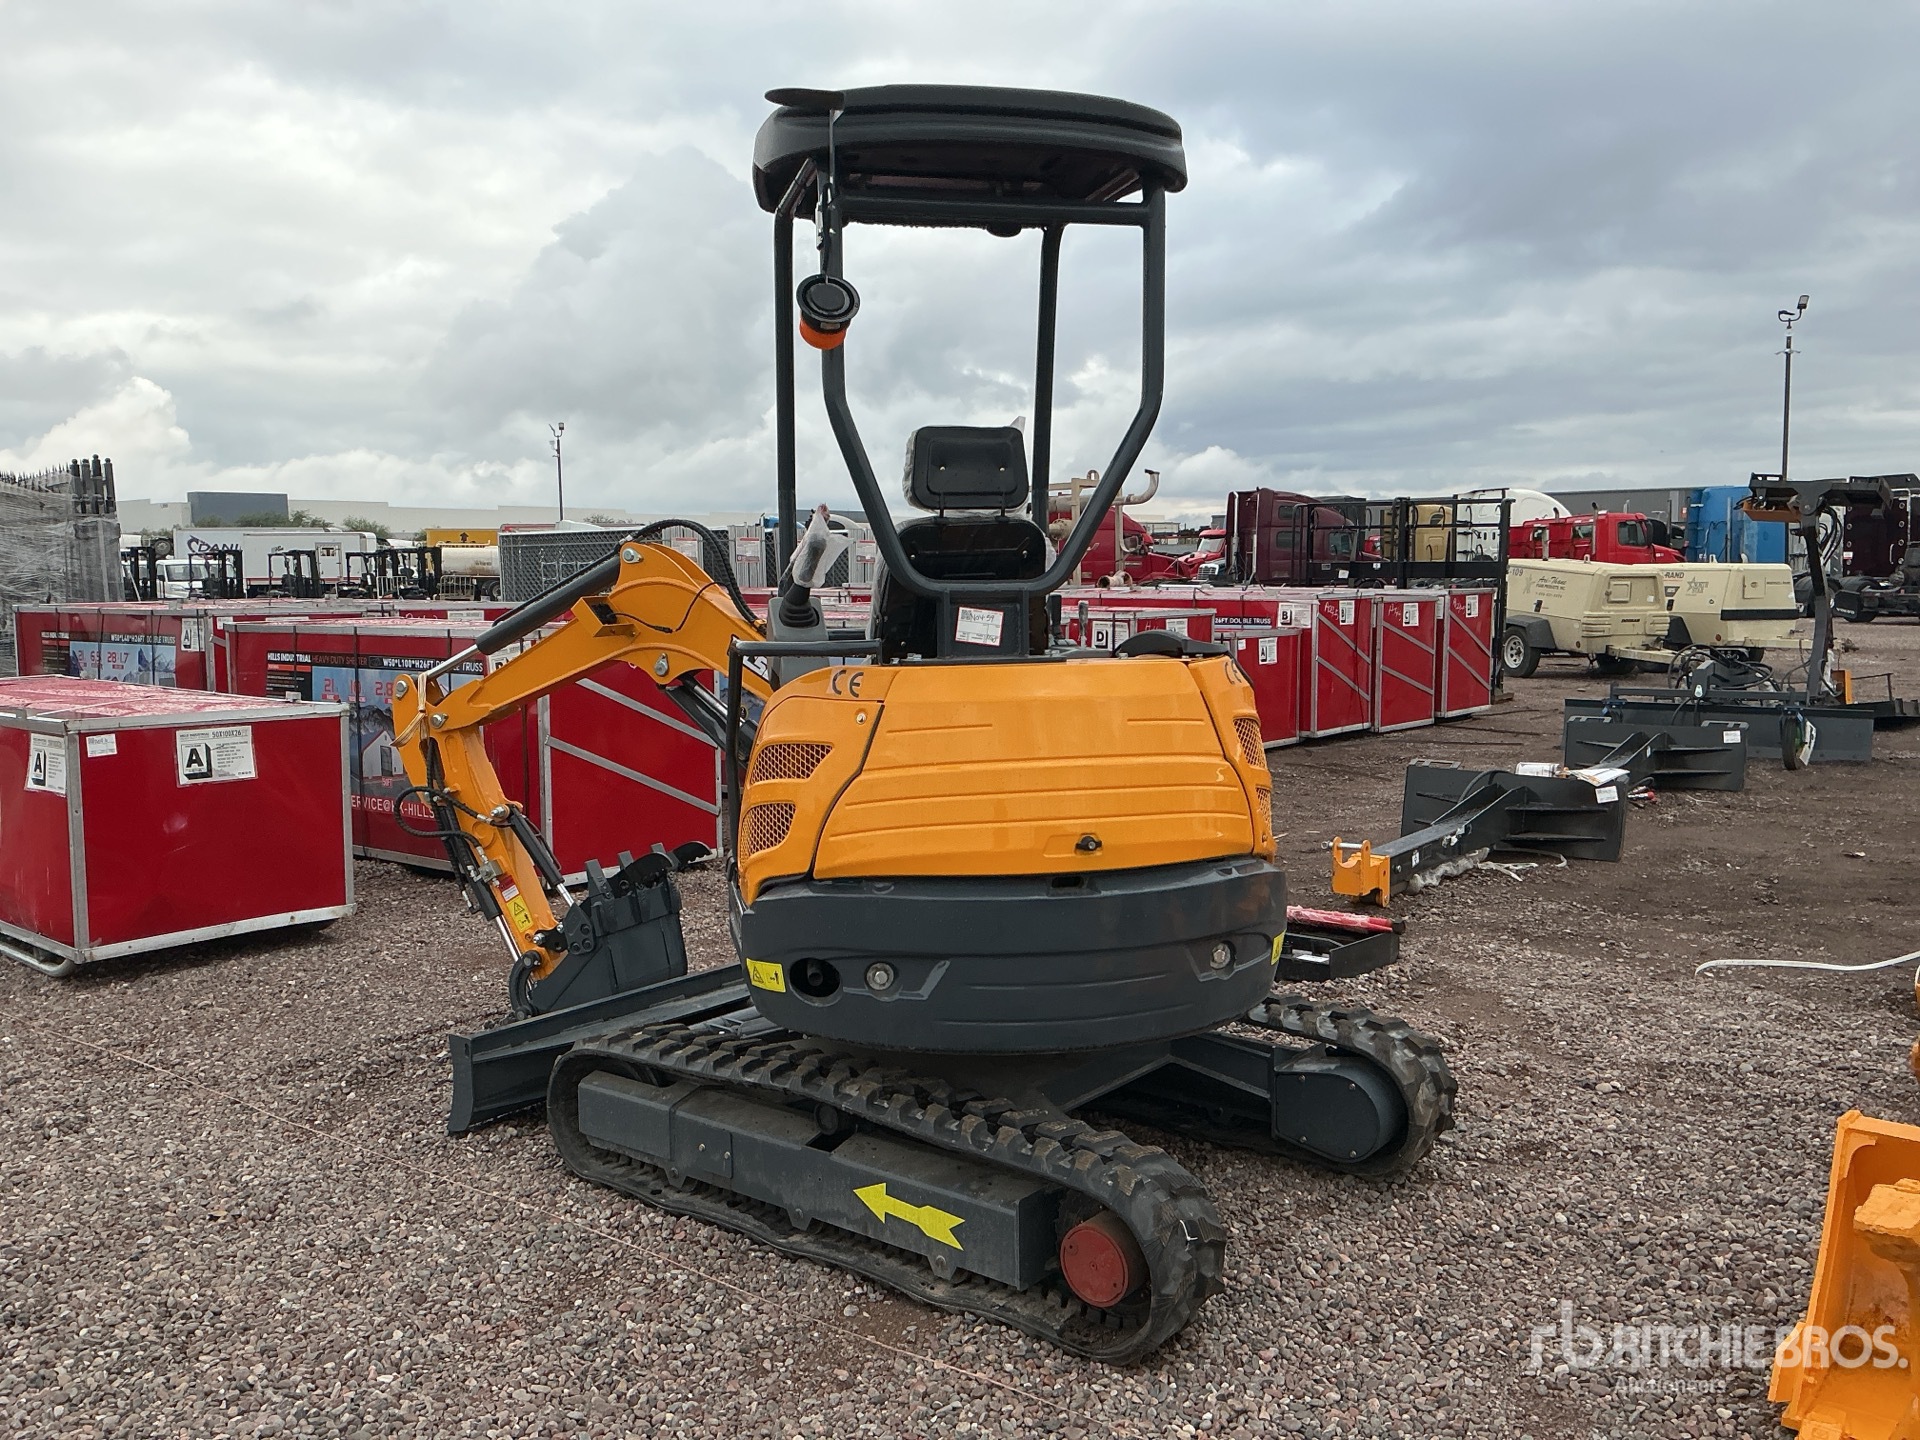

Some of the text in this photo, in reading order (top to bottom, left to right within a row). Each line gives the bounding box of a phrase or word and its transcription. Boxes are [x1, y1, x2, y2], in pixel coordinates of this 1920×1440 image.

[1508, 568, 1523, 576] -109
[1282, 610, 1288, 620] B
[1097, 630, 1104, 642] D
[267, 652, 280, 661] HILLS
[281, 653, 311, 663] INDUTRIAL
[329, 656, 345, 665] DUTY
[346, 657, 368, 666] SHETER
[462, 662, 483, 672] TRUSS
[324, 678, 334, 692] 21
[34, 753, 42, 772] A
[186, 748, 204, 768] A
